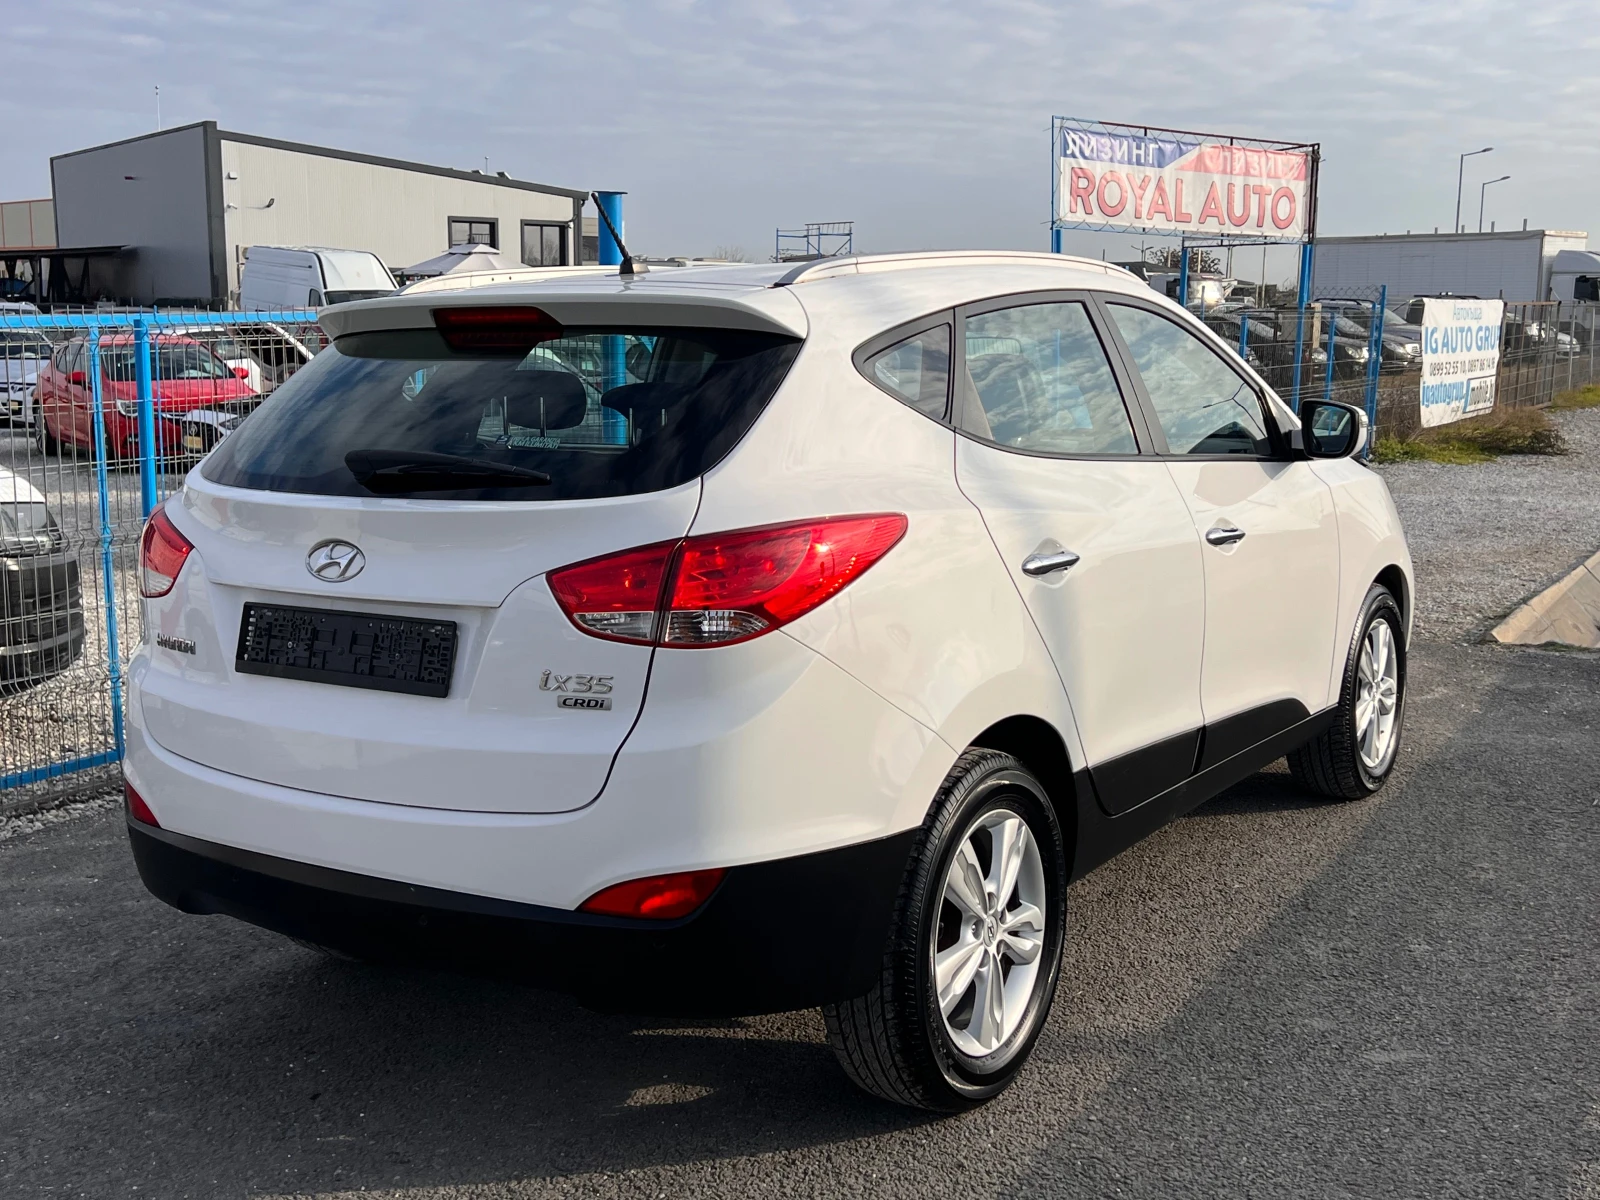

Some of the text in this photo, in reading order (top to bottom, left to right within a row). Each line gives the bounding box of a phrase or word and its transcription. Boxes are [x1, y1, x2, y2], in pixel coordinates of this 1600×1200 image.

[1066, 132, 1159, 165] ЛИЗИНГ
[1069, 167, 1297, 230] ROYAL AUTO
[1424, 326, 1439, 355] IG
[1441, 326, 1473, 354] AUTO
[1429, 361, 1444, 377] 0899
[1444, 361, 1452, 376] 52
[1452, 360, 1459, 375] 55
[539, 668, 614, 694] ix35
[562, 697, 605, 709] CRDi
